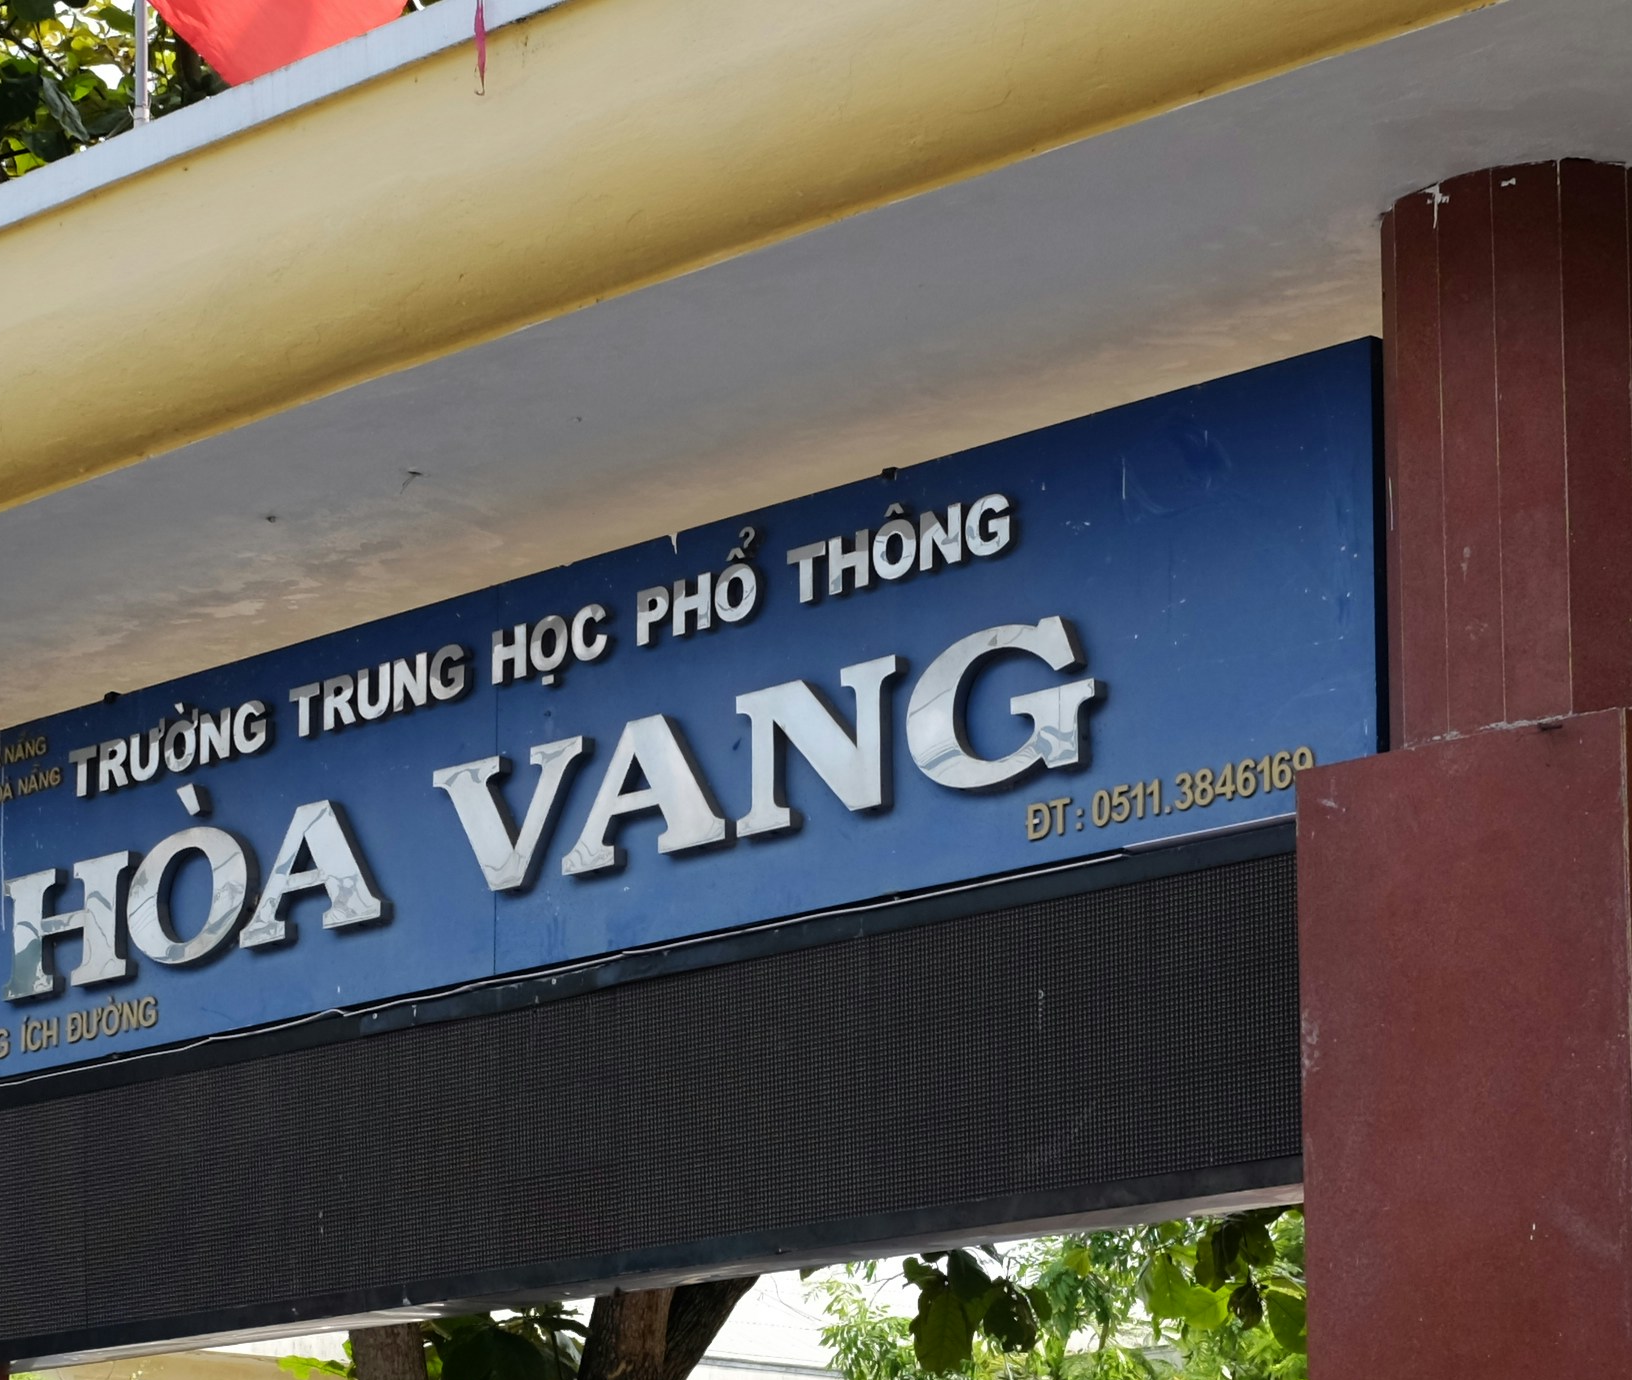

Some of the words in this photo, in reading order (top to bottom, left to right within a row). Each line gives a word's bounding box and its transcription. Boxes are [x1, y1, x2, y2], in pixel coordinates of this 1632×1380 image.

[69, 702, 266, 797] TRƯỜNG
[288, 643, 466, 737] TRUNG
[491, 603, 609, 686] HỌC
[636, 526, 757, 647] PHỔ
[786, 493, 1013, 604] THÔNG
[2, 784, 386, 1002] HÒA
[432, 615, 1100, 892] VANG
[21, 1014, 60, 1054] ÍCH
[65, 995, 159, 1044] ĐƯỜNG
